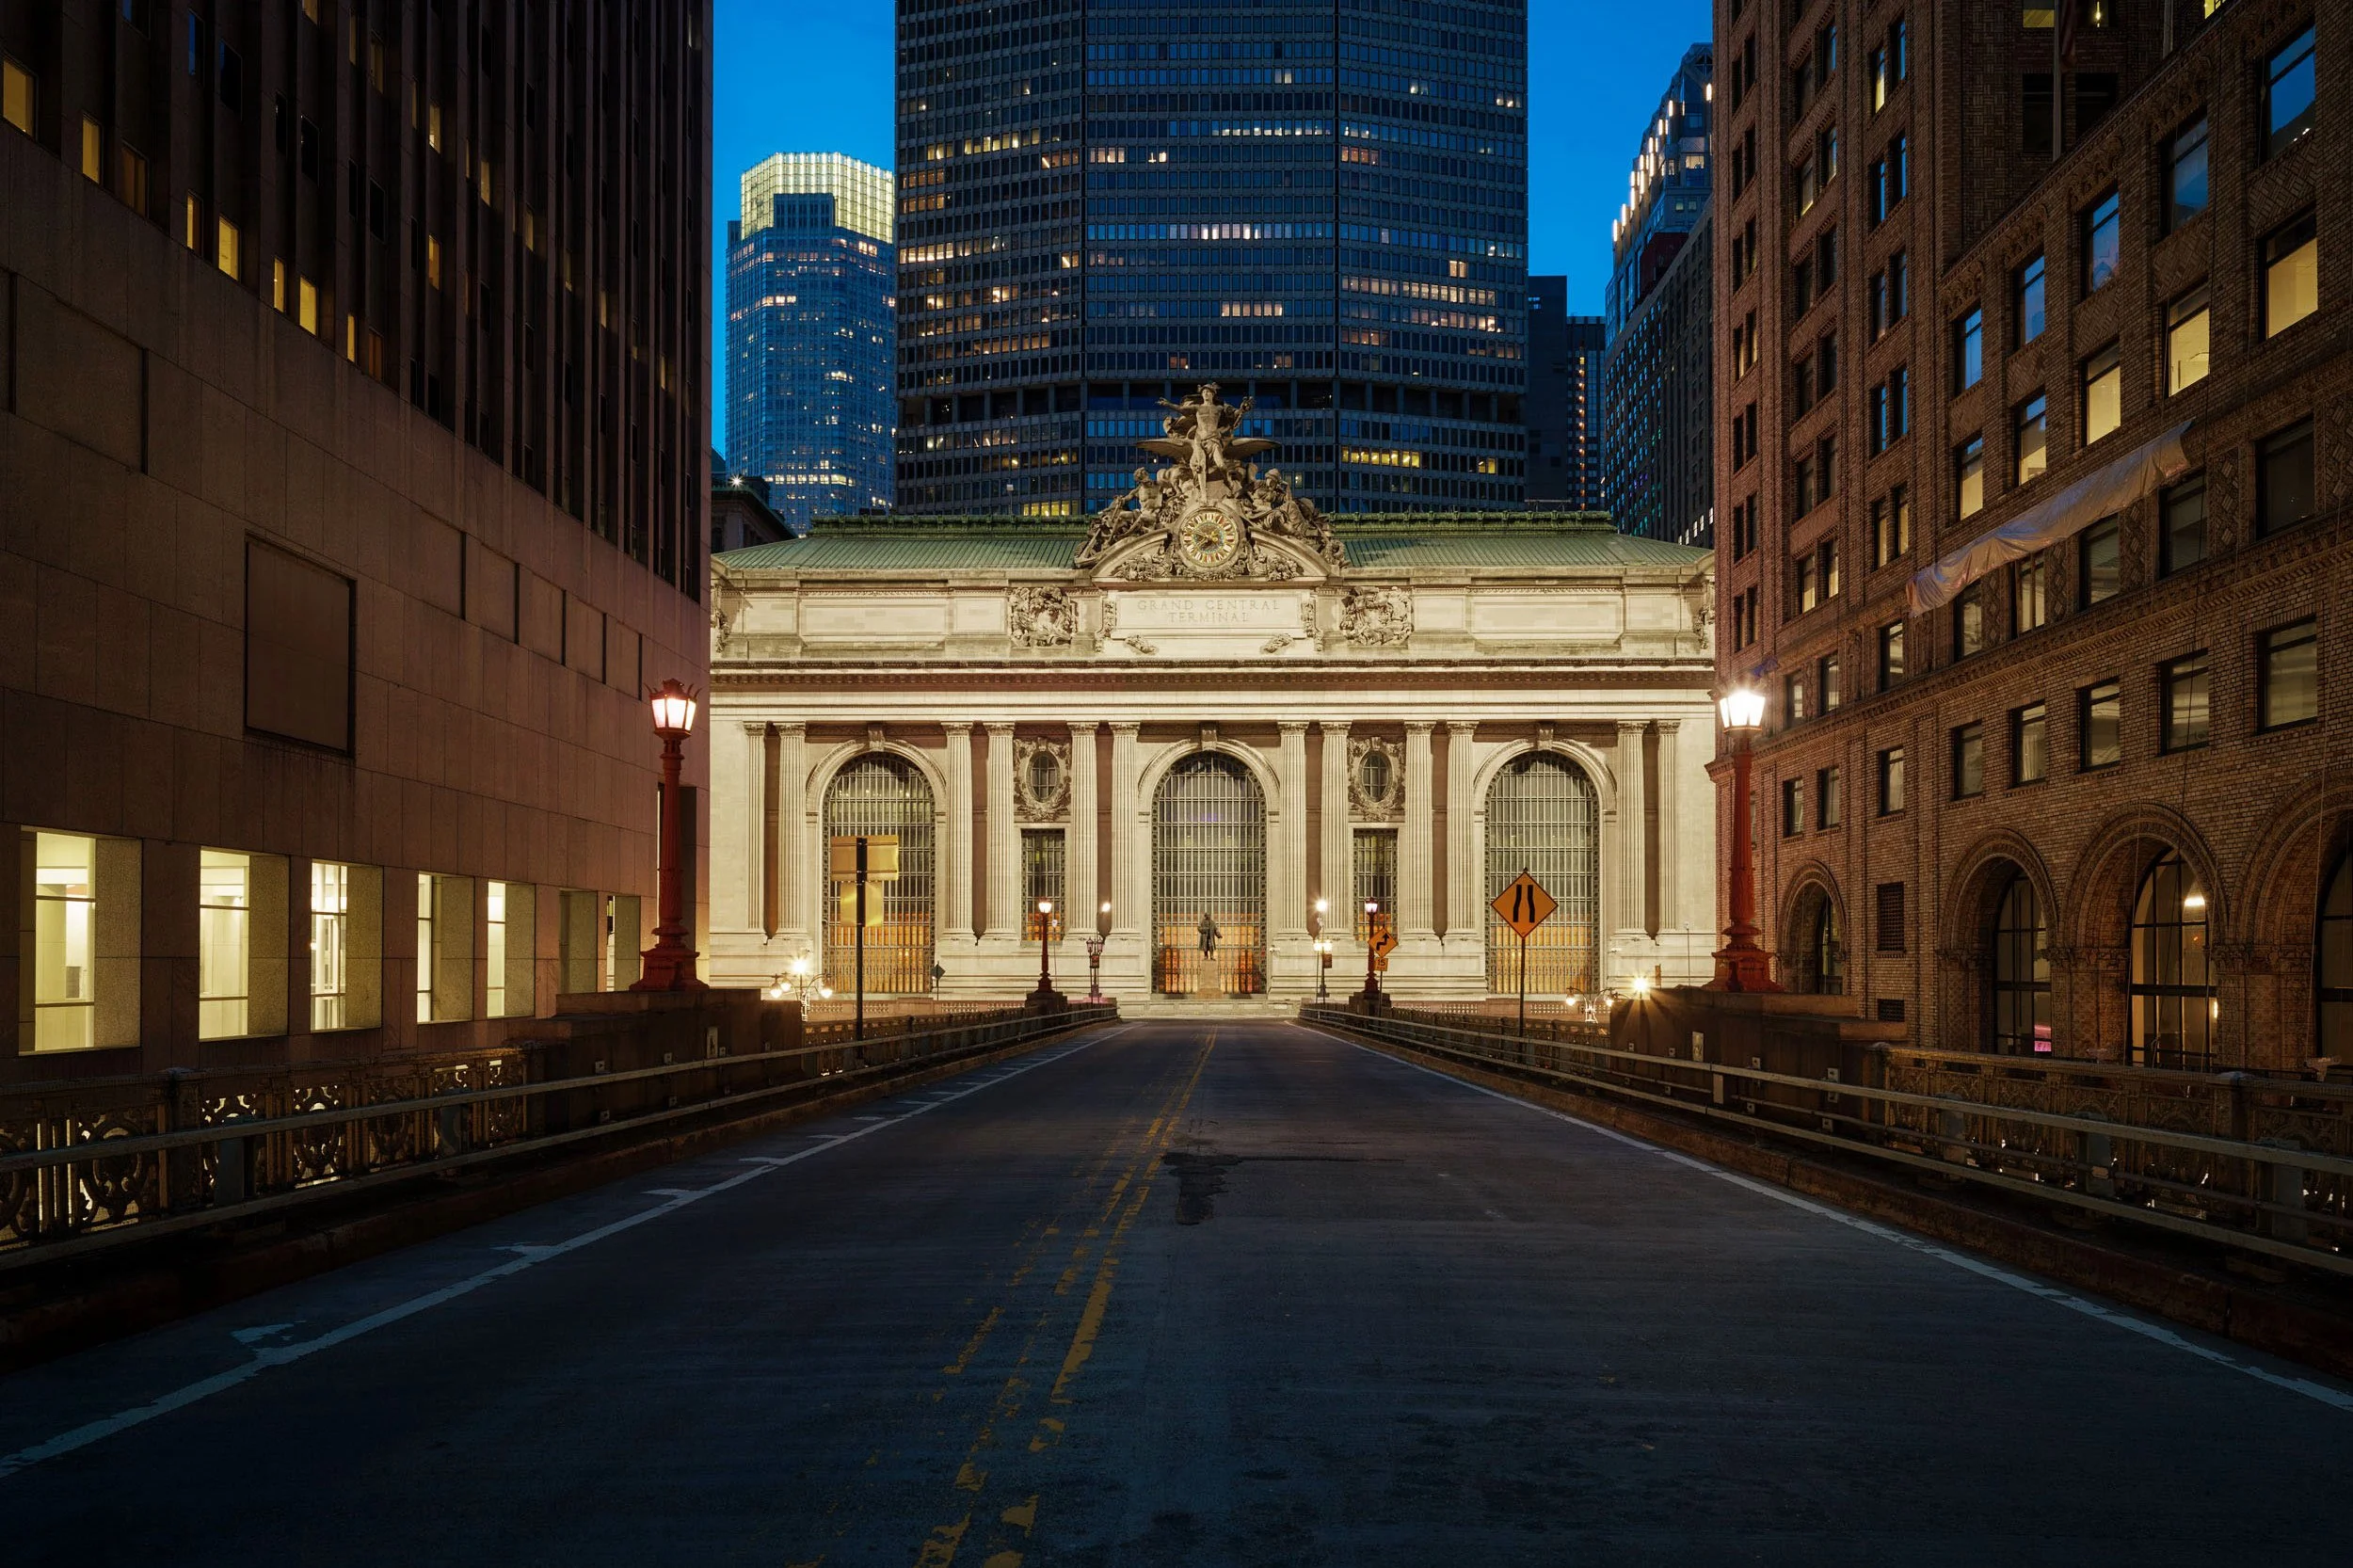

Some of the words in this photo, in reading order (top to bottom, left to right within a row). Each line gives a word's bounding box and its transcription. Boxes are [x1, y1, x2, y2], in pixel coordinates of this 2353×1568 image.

[1138, 600, 1193, 610] GRAND
[1205, 600, 1280, 610] CENTRAL
[1168, 612, 1250, 622] TERMINAL
